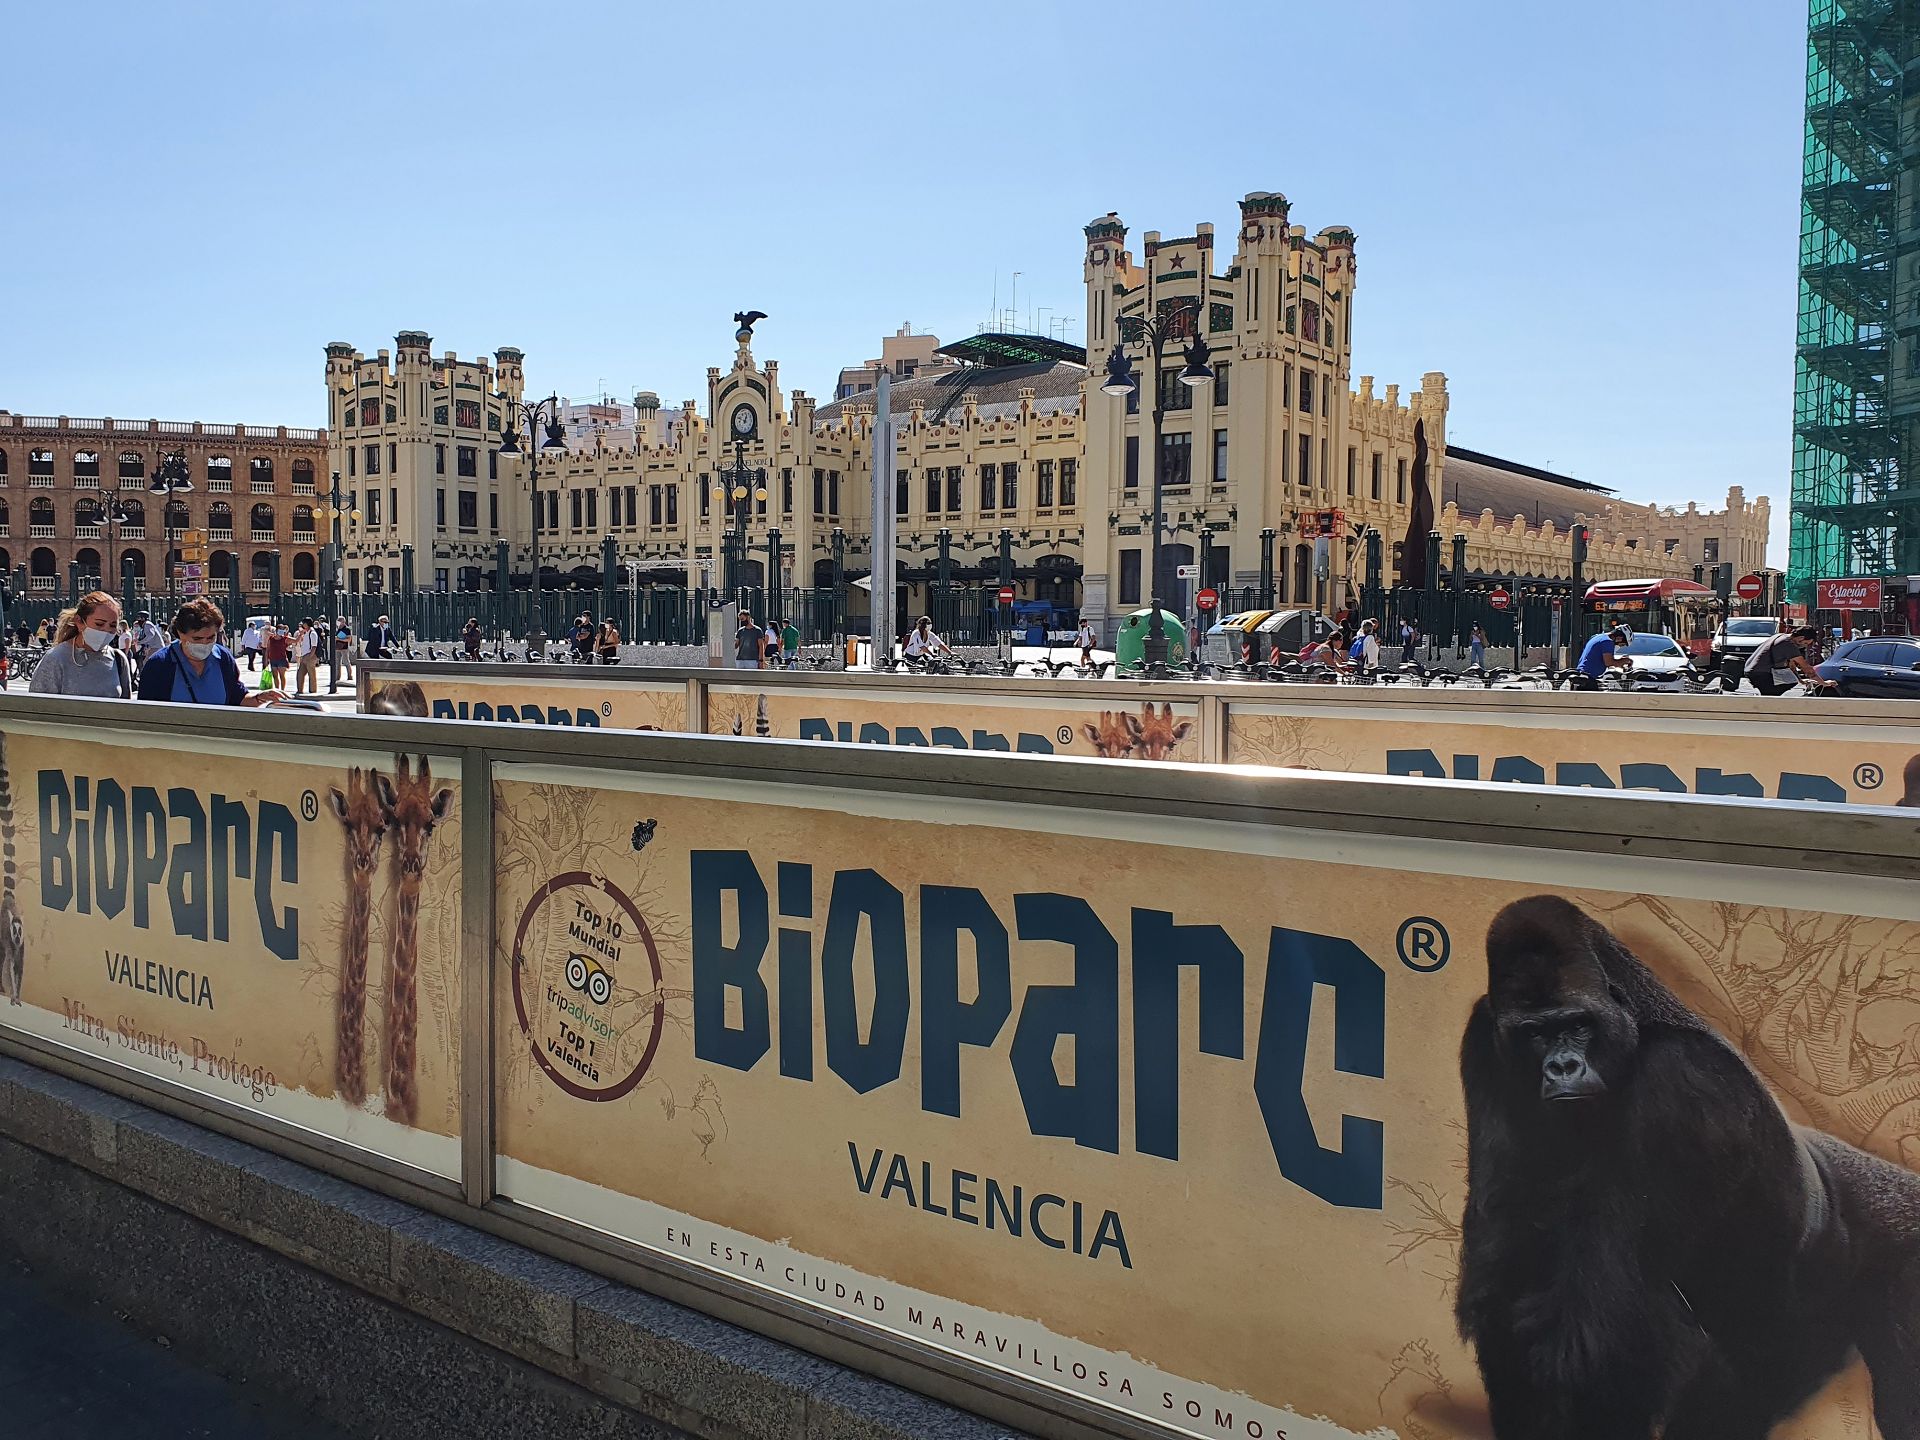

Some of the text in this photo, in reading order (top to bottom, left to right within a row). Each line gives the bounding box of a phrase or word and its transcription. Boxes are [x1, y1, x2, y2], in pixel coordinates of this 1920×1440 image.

[1595, 601, 1606, 612] 63
[1828, 583, 1868, 598] Estación
[568, 921, 621, 962] Mundial
[576, 900, 622, 939] Top 10
[105, 950, 214, 1010] VALENCIA
[547, 985, 616, 1039] tripadvisor
[61, 997, 278, 1103] Mira, Siente, Protege
[547, 1037, 599, 1084] Valencia
[559, 1021, 595, 1057] Top 1
[847, 1140, 1133, 1271] VALENCIA
[666, 1227, 1287, 1440] EN ESTA CIUDAD MARAVILLOSA SOMOS
